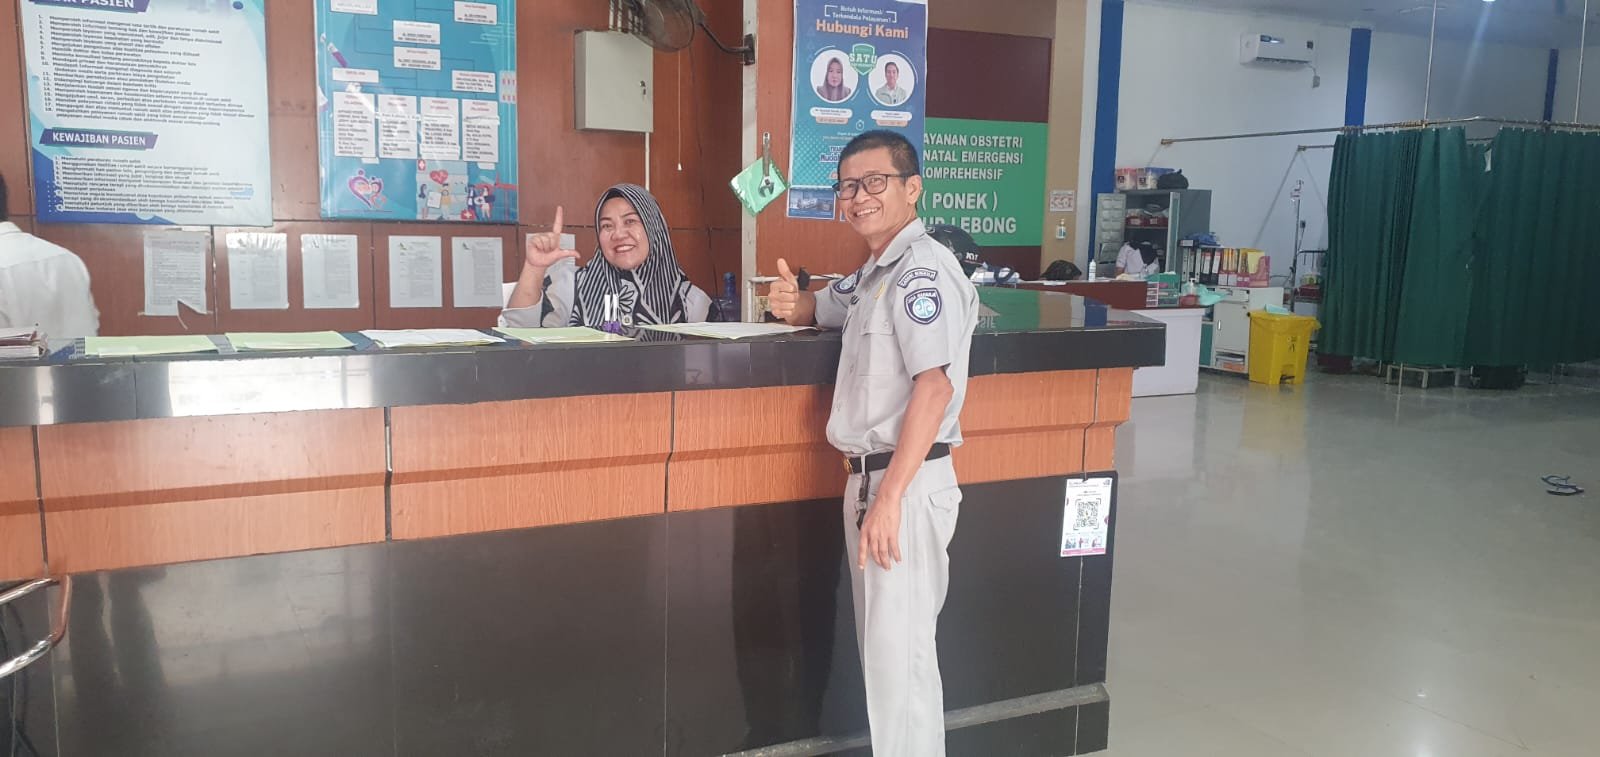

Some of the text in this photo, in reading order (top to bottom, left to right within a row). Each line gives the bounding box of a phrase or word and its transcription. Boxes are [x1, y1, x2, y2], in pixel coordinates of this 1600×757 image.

[816, 19, 909, 38] Hubungi Kami
[849, 53, 877, 64] SATU
[53, 132, 146, 145] KEWAJIBAN PASIEN
[923, 133, 1023, 148] AYANAN OBSTETRI
[923, 149, 1023, 164] NATAL EMERGENSI
[932, 192, 987, 210] PONEK
